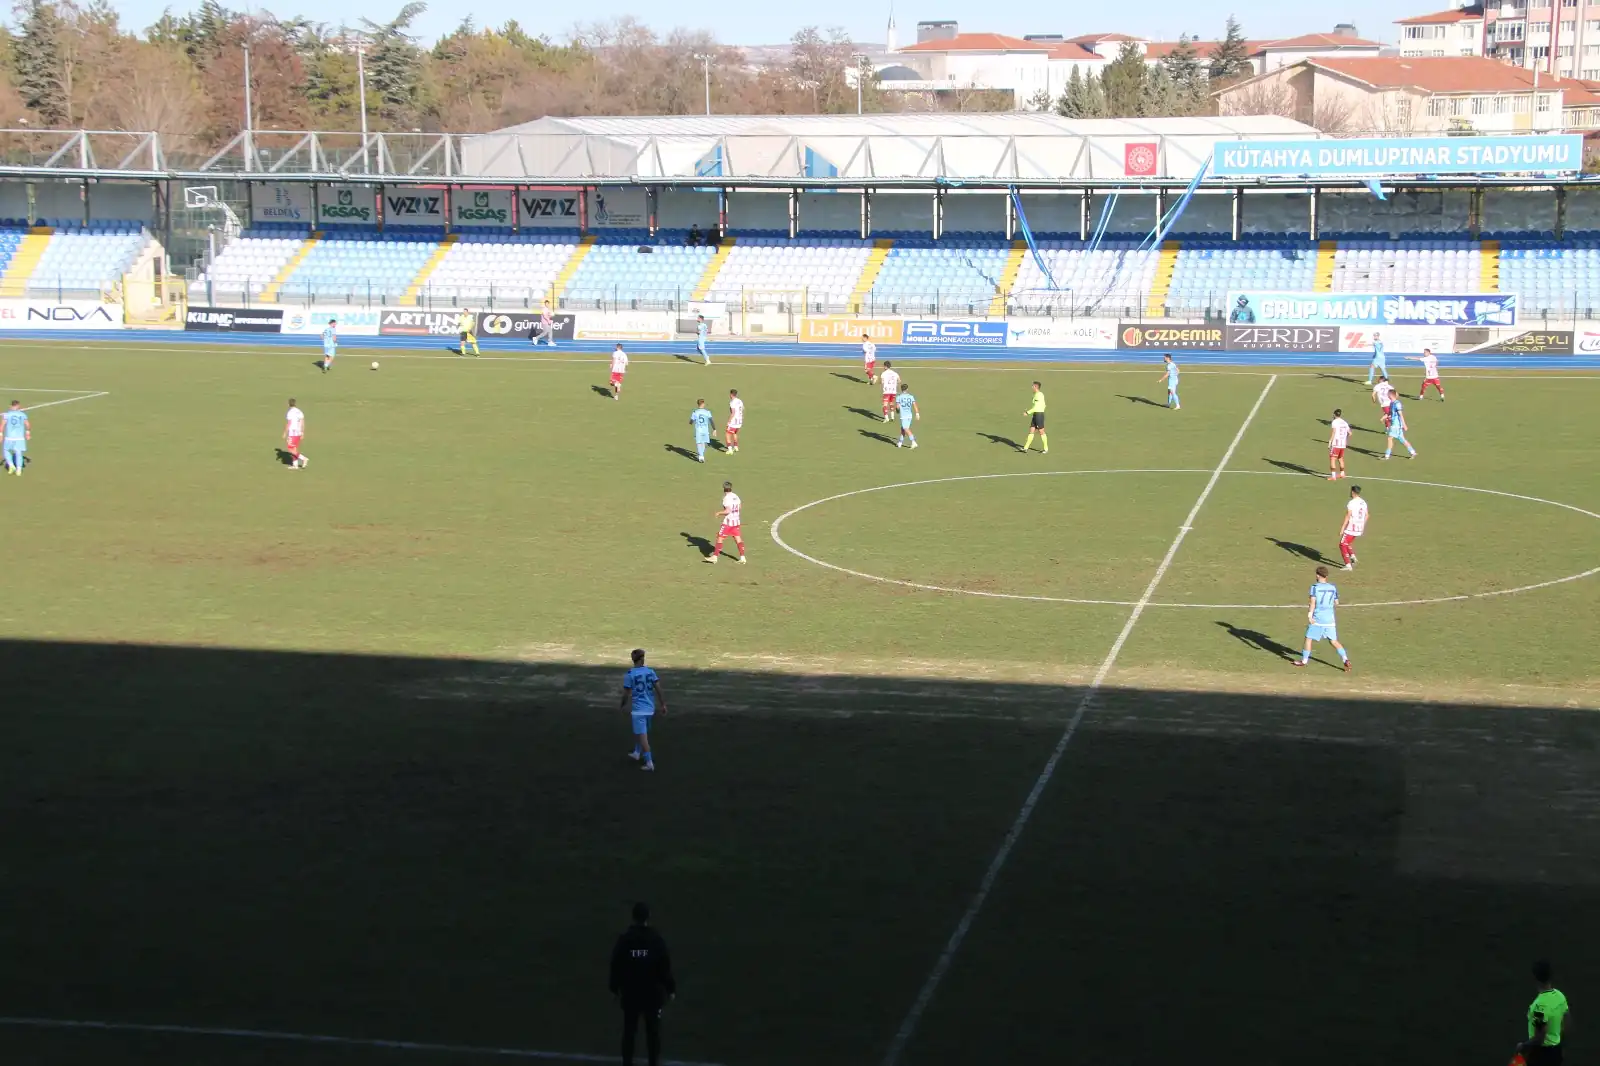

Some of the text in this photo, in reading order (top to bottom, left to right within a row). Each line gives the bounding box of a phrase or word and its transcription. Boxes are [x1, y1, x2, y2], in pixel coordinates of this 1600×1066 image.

[1223, 144, 1569, 168] KÜTAHYA DUMLUPINAR STADYUMU
[27, 306, 114, 322] NOVA
[1261, 296, 1470, 325] GRUP MAVİ ŞİMŞEK
[383, 312, 461, 326] ARTLIN
[428, 326, 462, 335] HOM
[809, 321, 893, 338] La Plantin
[907, 322, 1004, 336] ACL
[1233, 328, 1334, 344] ZERDE
[698, 414, 705, 424] 5
[1317, 589, 1335, 605] 77
[633, 673, 654, 693] 55
[629, 949, 648, 957] TFF
